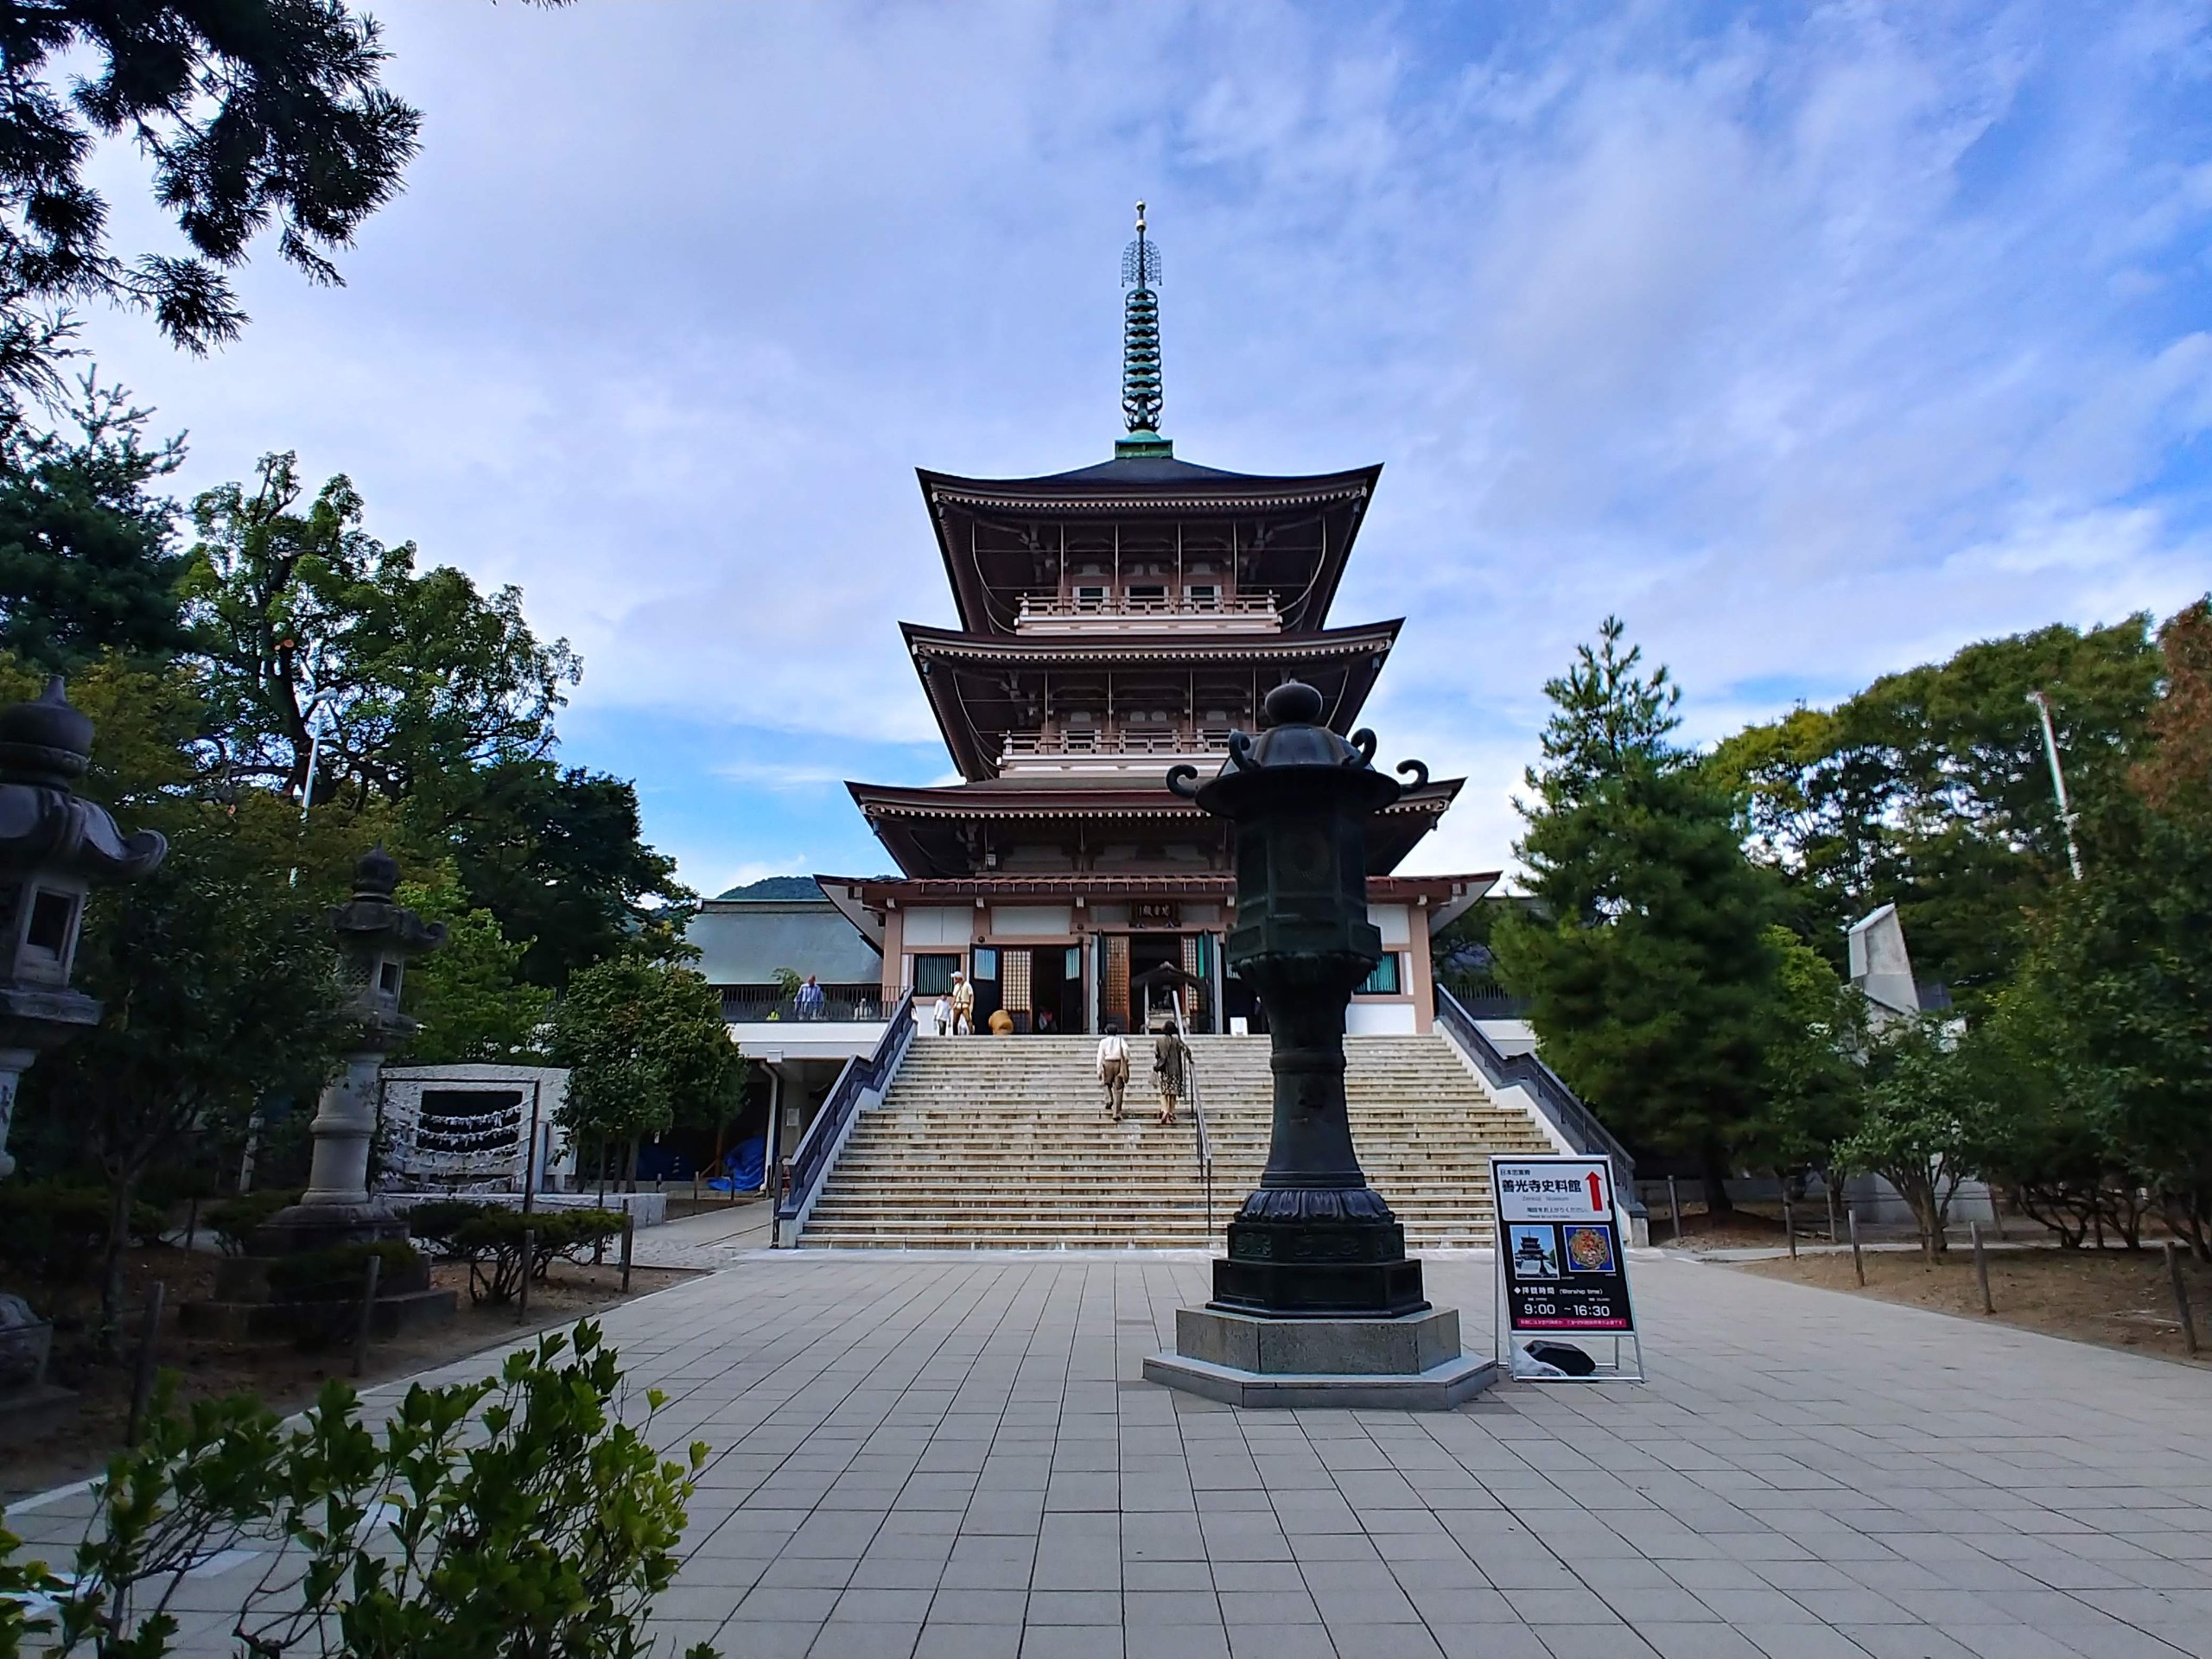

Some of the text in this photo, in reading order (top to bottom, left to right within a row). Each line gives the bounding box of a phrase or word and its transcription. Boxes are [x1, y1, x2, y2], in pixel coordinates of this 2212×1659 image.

[1502, 1179, 1582, 1193] 善光寺史料館
[1524, 1303, 1555, 1314] 9:00
